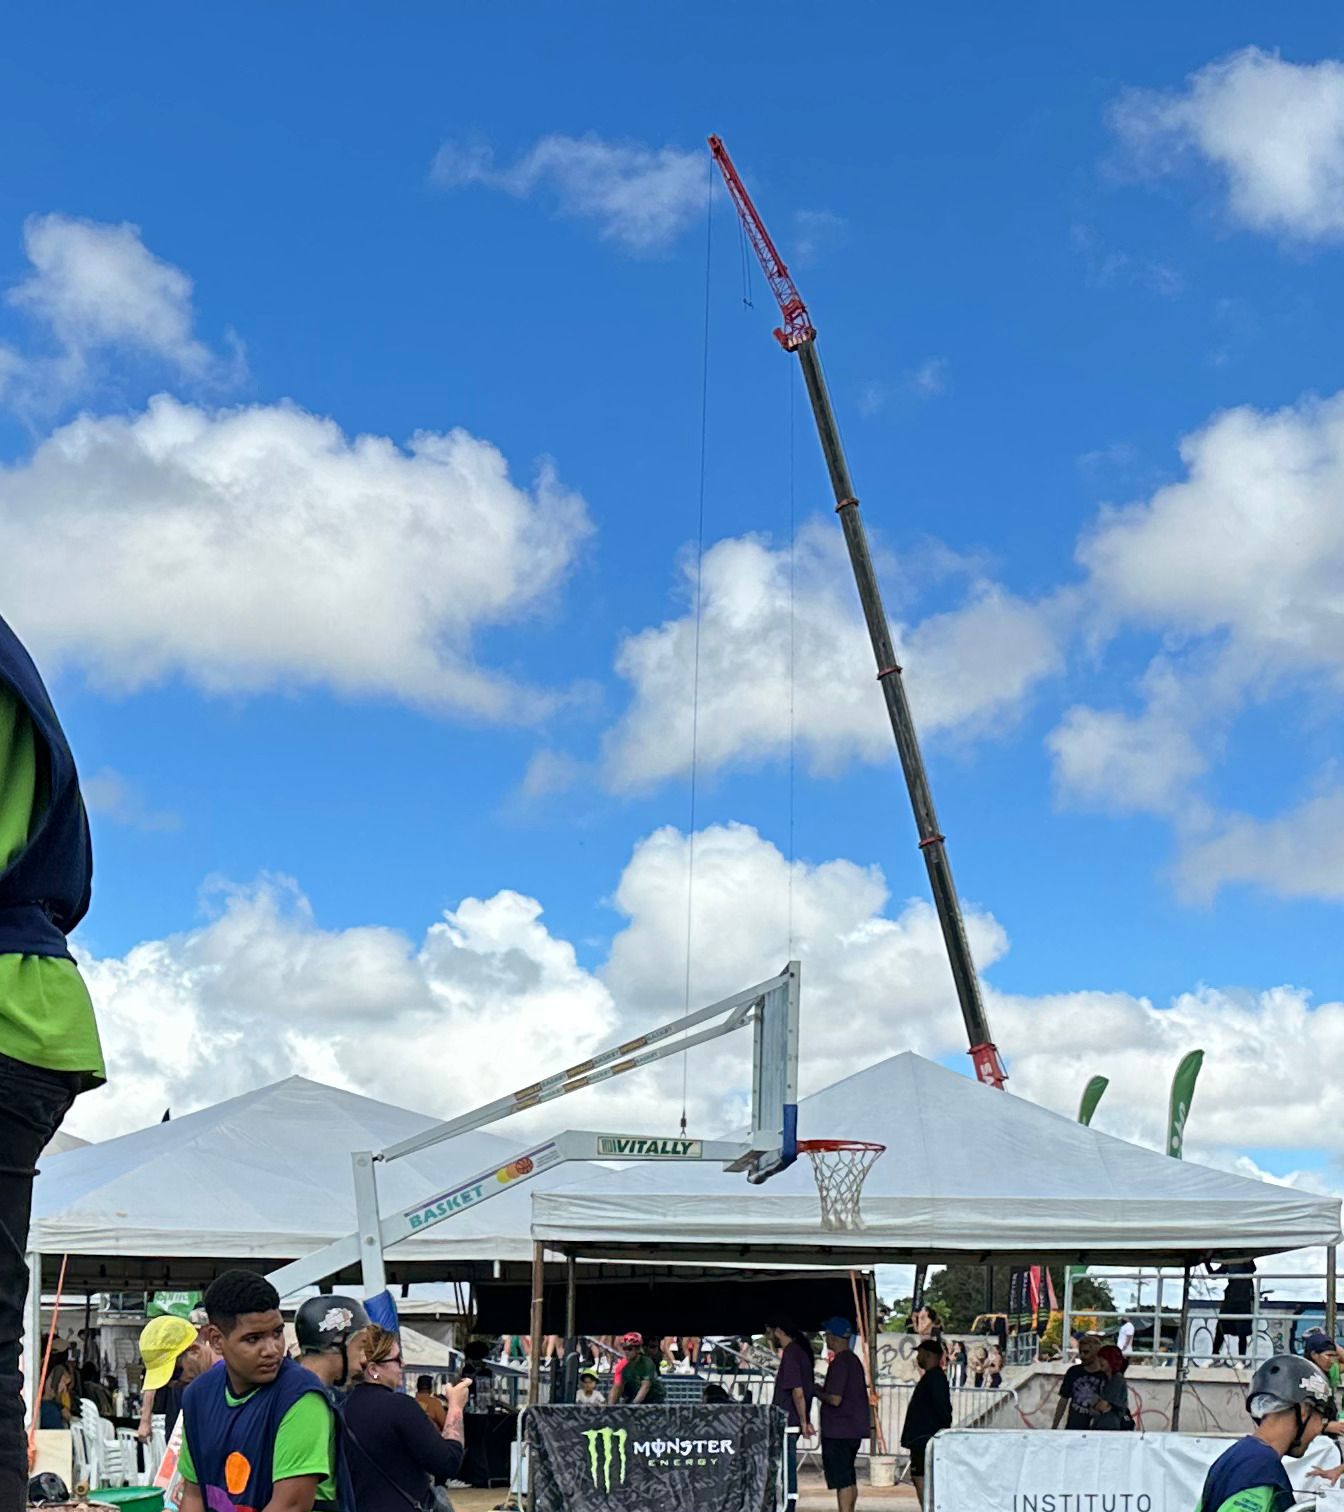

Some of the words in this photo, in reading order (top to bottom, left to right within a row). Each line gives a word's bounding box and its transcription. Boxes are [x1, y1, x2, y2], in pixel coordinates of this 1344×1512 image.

[616, 1139, 694, 1156] VITALLY
[408, 1184, 484, 1230] BASKET
[633, 1438, 736, 1458] MONSTER
[648, 1458, 718, 1467] ENERGY
